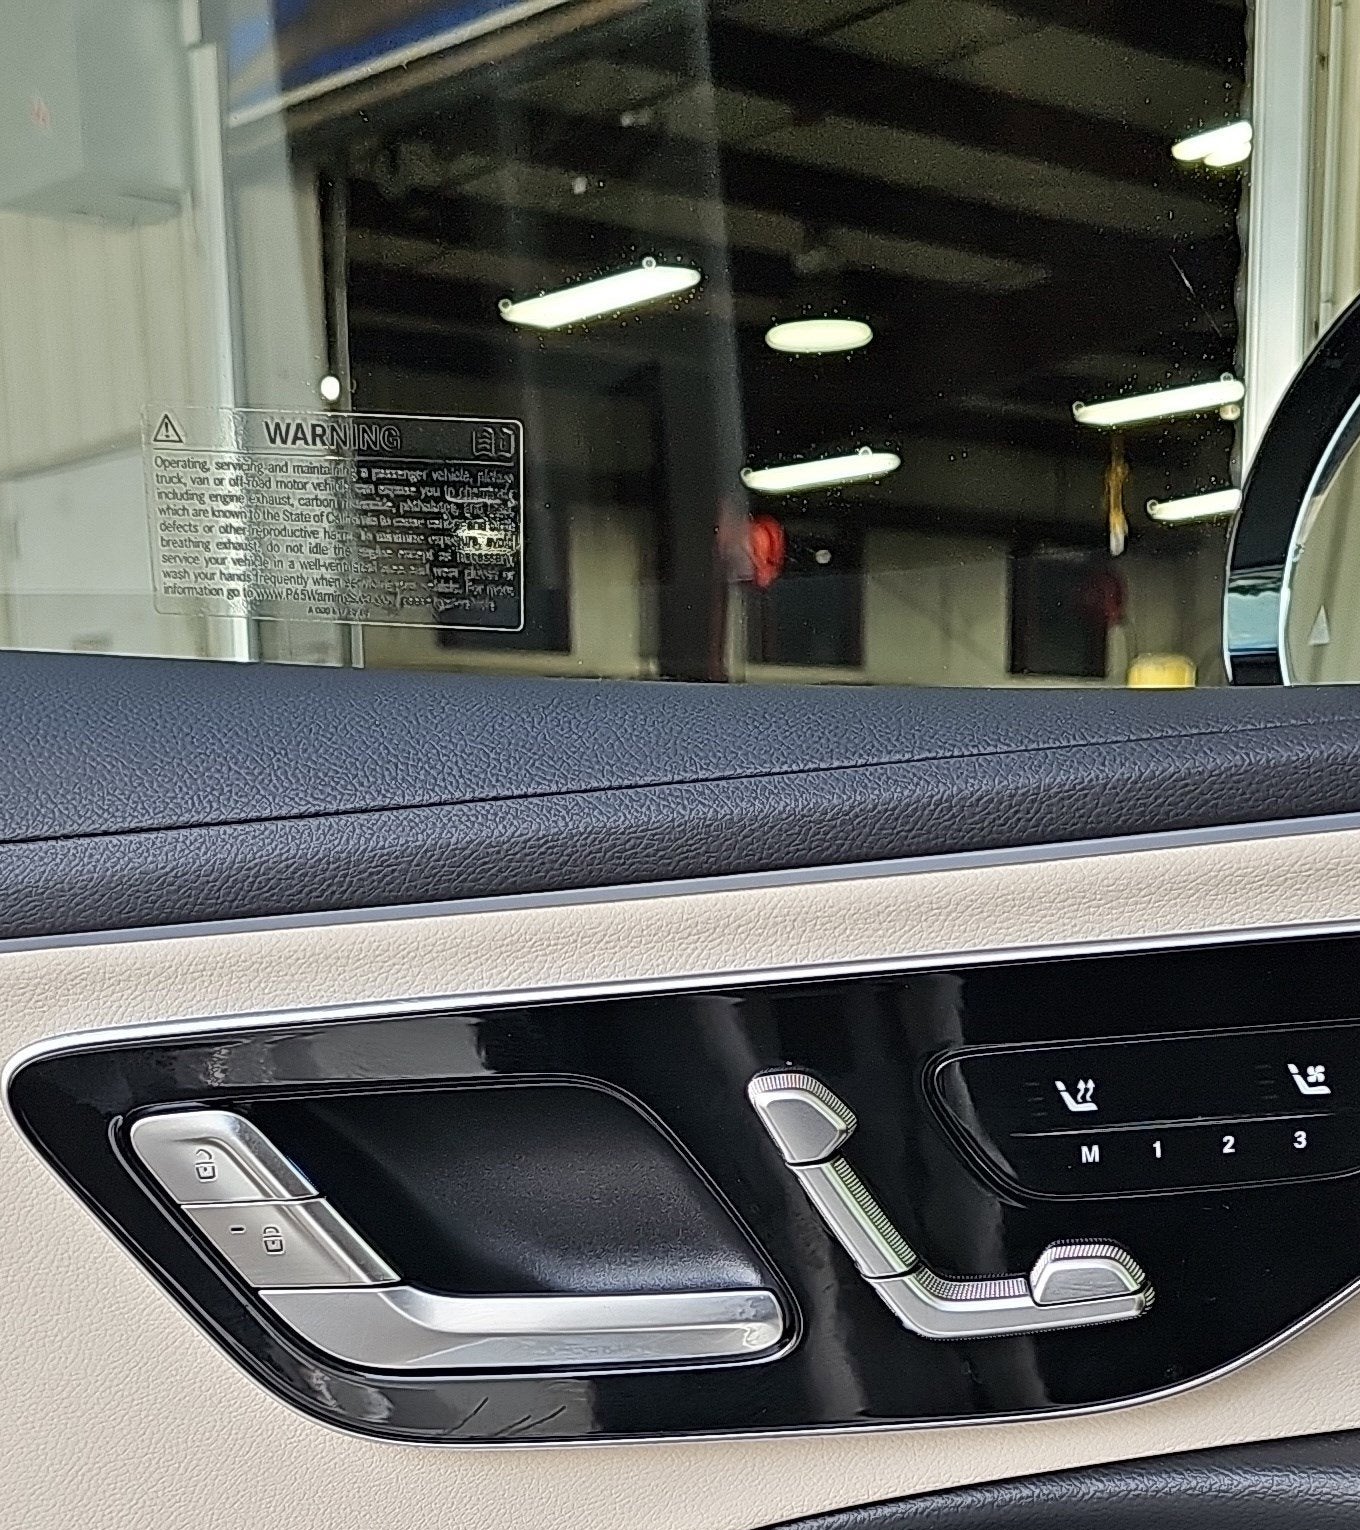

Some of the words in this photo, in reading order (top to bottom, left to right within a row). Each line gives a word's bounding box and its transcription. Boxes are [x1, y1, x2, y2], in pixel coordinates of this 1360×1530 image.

[264, 420, 402, 451] WARNING
[155, 456, 210, 473] Operating,
[215, 461, 263, 475] servicing
[268, 462, 288, 474] and
[431, 469, 473, 483] vehicle,
[155, 473, 187, 487] truck,
[190, 476, 209, 486] van
[214, 477, 225, 487] or
[229, 476, 272, 490] off-road
[276, 478, 307, 491] motor
[420, 486, 440, 499] you
[157, 488, 205, 505] including
[209, 493, 244, 506] engine
[249, 491, 294, 507] exhaust,
[298, 495, 335, 508] carbon
[158, 504, 189, 517] which
[192, 508, 208, 518] are
[211, 506, 247, 520] known
[249, 508, 259, 520] to
[262, 508, 280, 521] the
[283, 509, 311, 523] State
[313, 510, 324, 524] of
[160, 520, 198, 534] defects
[203, 524, 215, 534] or
[219, 523, 249, 536] other
[251, 524, 319, 540] reproductive
[160, 536, 211, 553] breathing
[267, 541, 280, 553] do
[285, 542, 304, 554] not
[308, 542, 328, 554] idle
[334, 543, 351, 556] the
[162, 554, 201, 564] service
[204, 555, 226, 568] your
[232, 555, 269, 568] vehicle
[274, 557, 283, 569] in
[288, 560, 295, 569] a
[163, 568, 190, 580] wash
[193, 571, 216, 584] your
[219, 570, 252, 583] hands
[254, 570, 308, 588] frequently
[312, 575, 341, 588] when
[163, 584, 224, 597] information
[226, 588, 240, 600] go
[243, 587, 254, 598] to
[1081, 1145, 1100, 1164] M
[1152, 1141, 1162, 1158] 1
[1222, 1135, 1235, 1154] 2
[1293, 1131, 1307, 1149] 3
